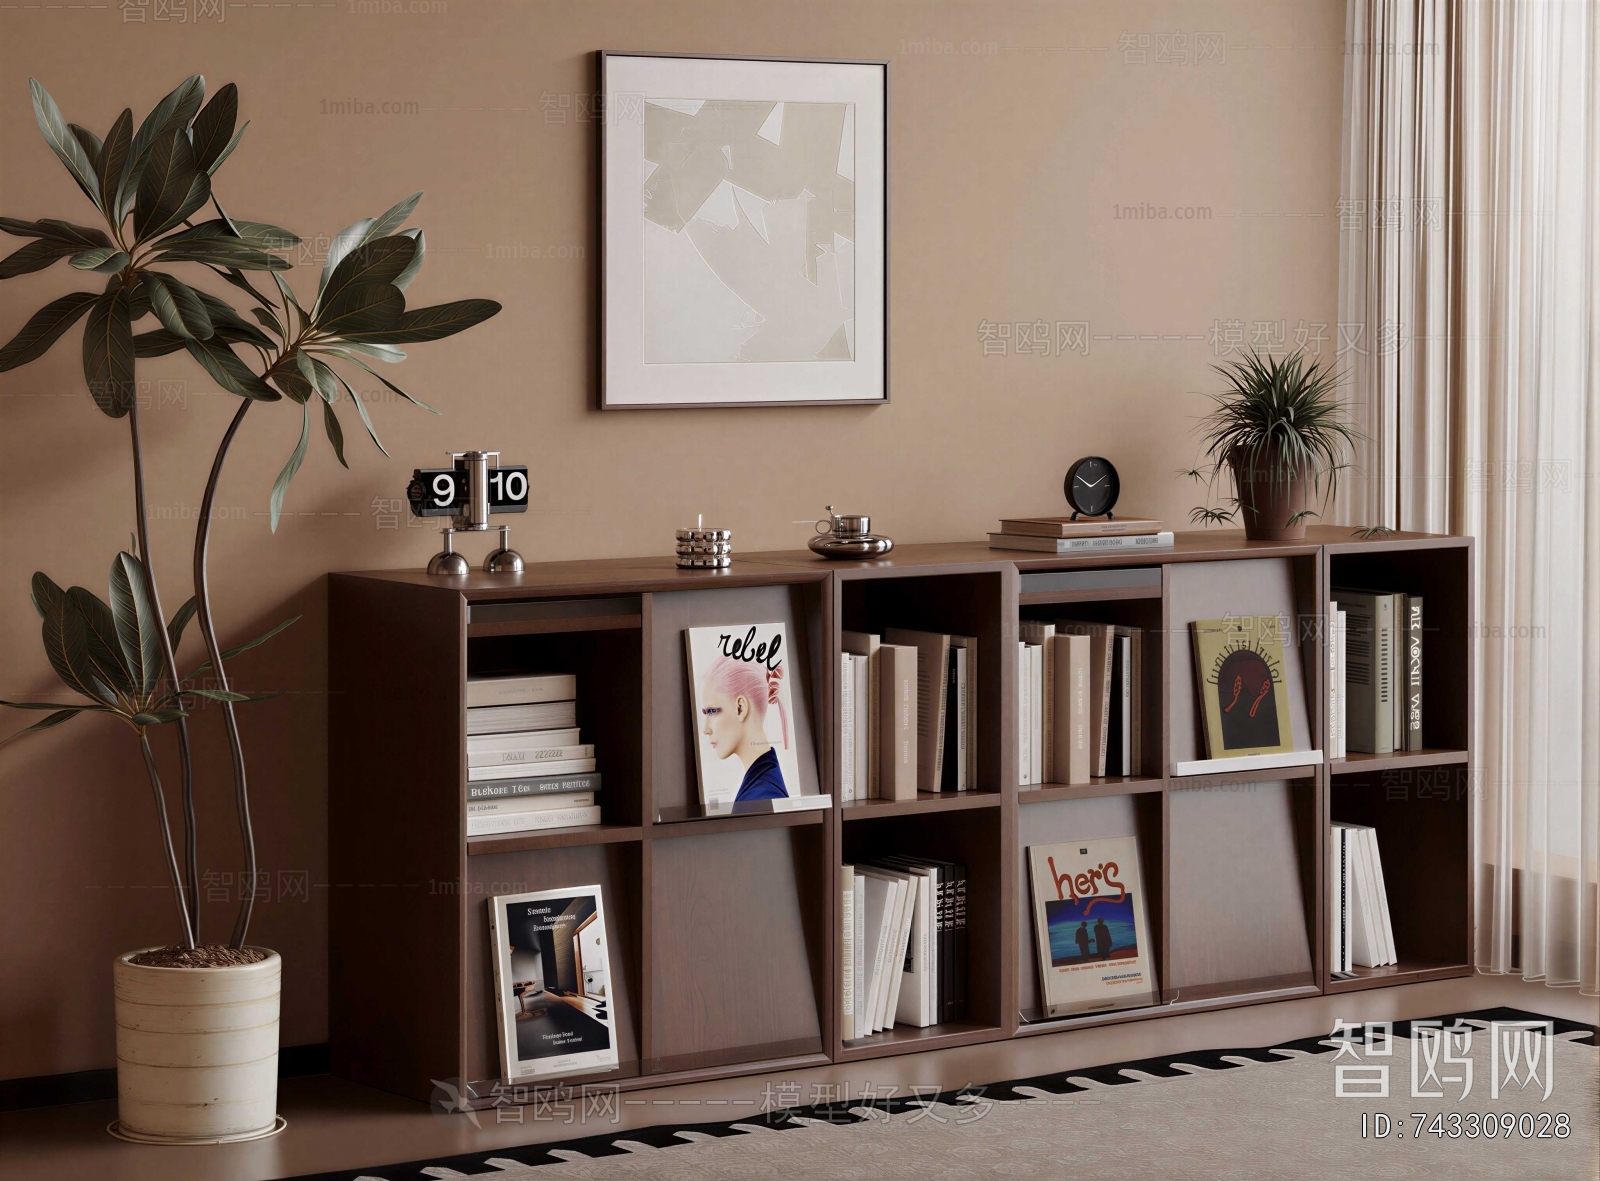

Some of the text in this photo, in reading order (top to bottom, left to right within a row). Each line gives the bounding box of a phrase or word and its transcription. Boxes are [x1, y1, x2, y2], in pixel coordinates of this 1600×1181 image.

[432, 474, 455, 507] 9
[490, 472, 528, 501] 10
[717, 626, 783, 671] rebel
